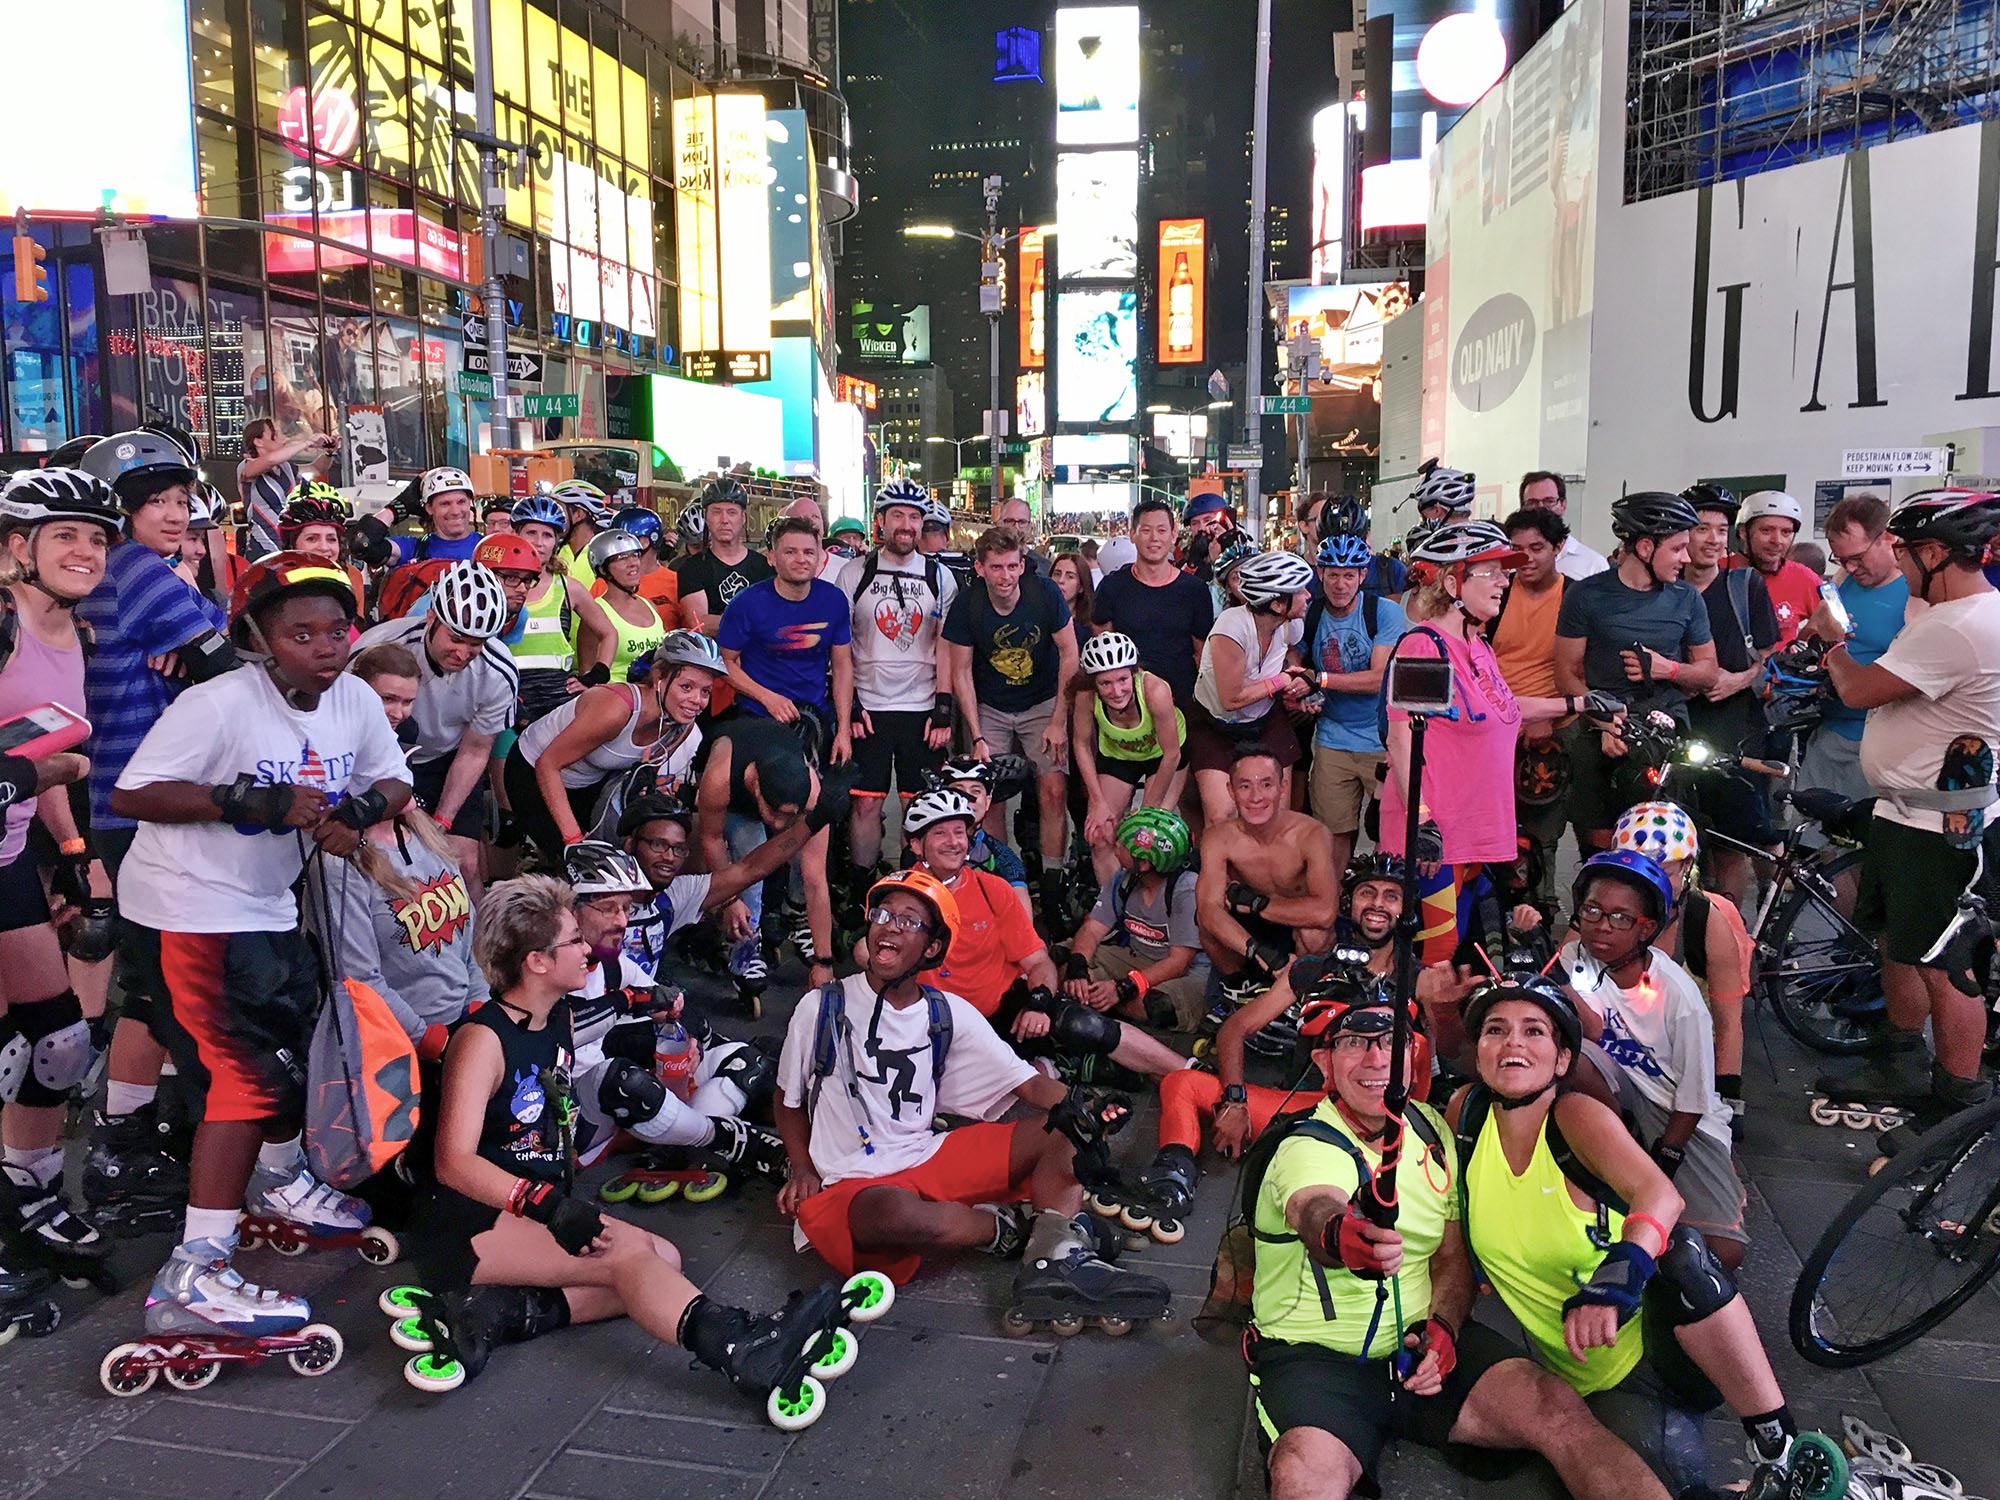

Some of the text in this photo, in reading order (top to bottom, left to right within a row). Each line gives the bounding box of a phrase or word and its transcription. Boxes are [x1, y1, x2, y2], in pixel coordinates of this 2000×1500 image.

[548, 59, 591, 119] THE
[724, 168, 763, 188] KING
[1460, 339, 1483, 385] OLD
[1485, 319, 1524, 377] NAVY
[474, 357, 531, 373] ON WAY
[460, 374, 493, 398] Broadway
[526, 397, 577, 415] W 44 St
[1265, 399, 1275, 412] W
[1280, 399, 1296, 412] 44
[1847, 450, 1933, 462] PEDESTRIAN FLOW ZONE
[1846, 463, 1894, 473] KEEP MOVING
[1466, 544, 1491, 556] LAZER
[870, 581, 888, 597] Big
[911, 582, 925, 598] Roll
[627, 639, 645, 653] Big
[396, 875, 470, 955] POW
[1130, 923, 1156, 938] DANGER
